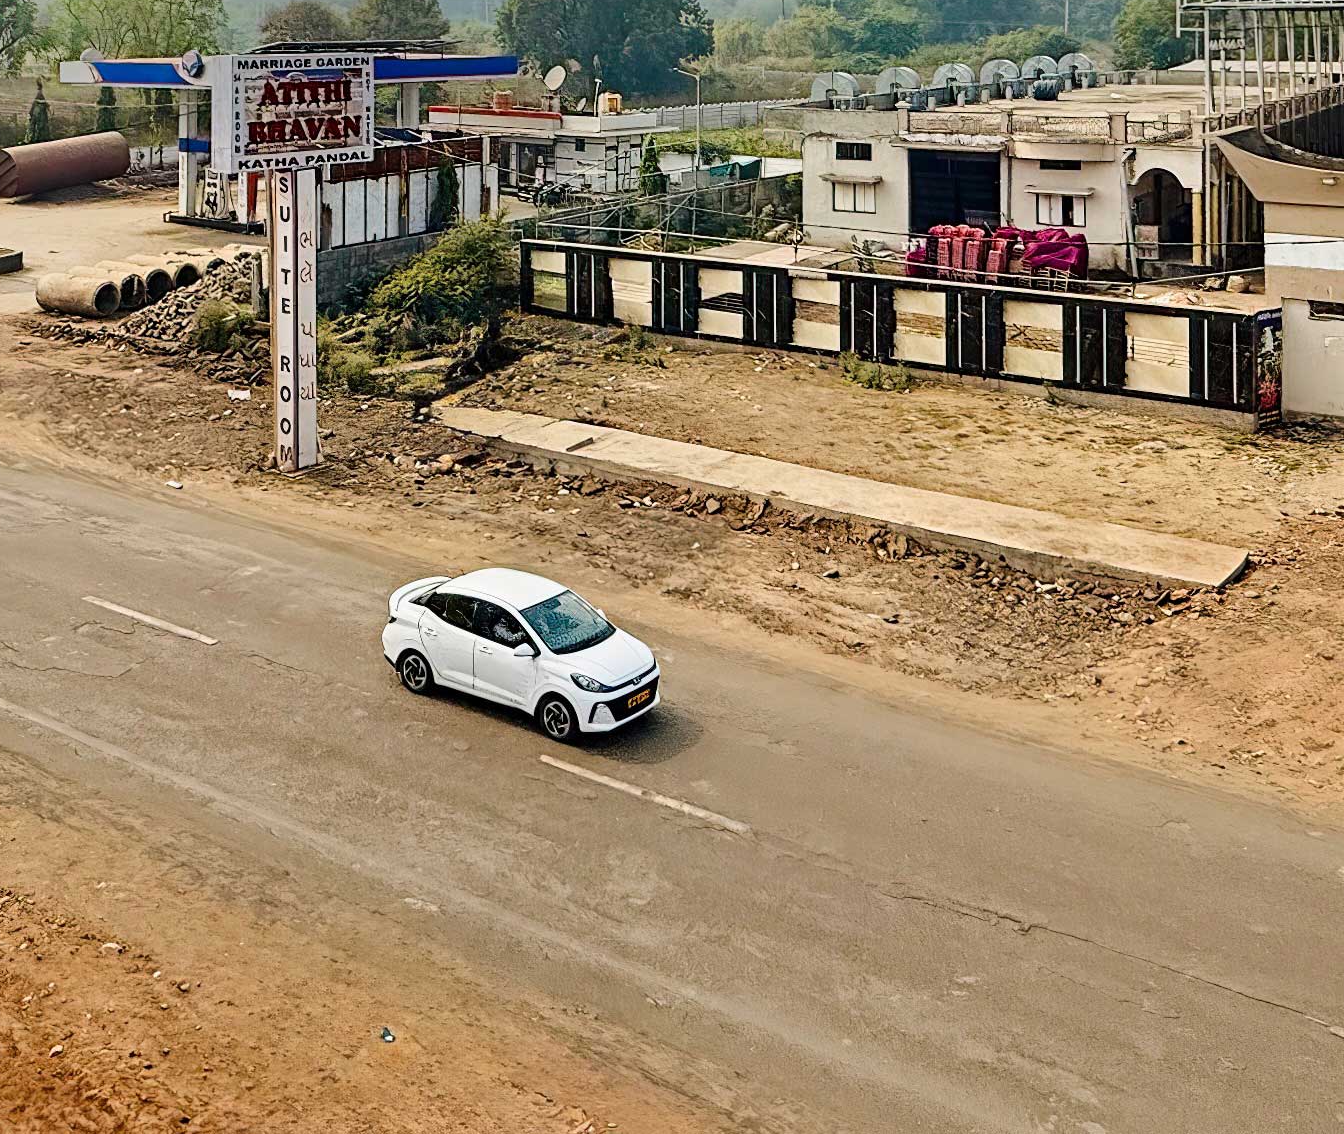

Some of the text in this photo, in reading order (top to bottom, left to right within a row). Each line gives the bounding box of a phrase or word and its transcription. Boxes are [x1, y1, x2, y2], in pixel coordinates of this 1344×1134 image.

[237, 57, 370, 70] MARRIAGE GARDEN
[256, 79, 353, 106] ATITHI
[247, 116, 363, 145] BHAVAN
[238, 151, 370, 170] KATHA PANDAL
[279, 176, 293, 463] SUITE ROOM
